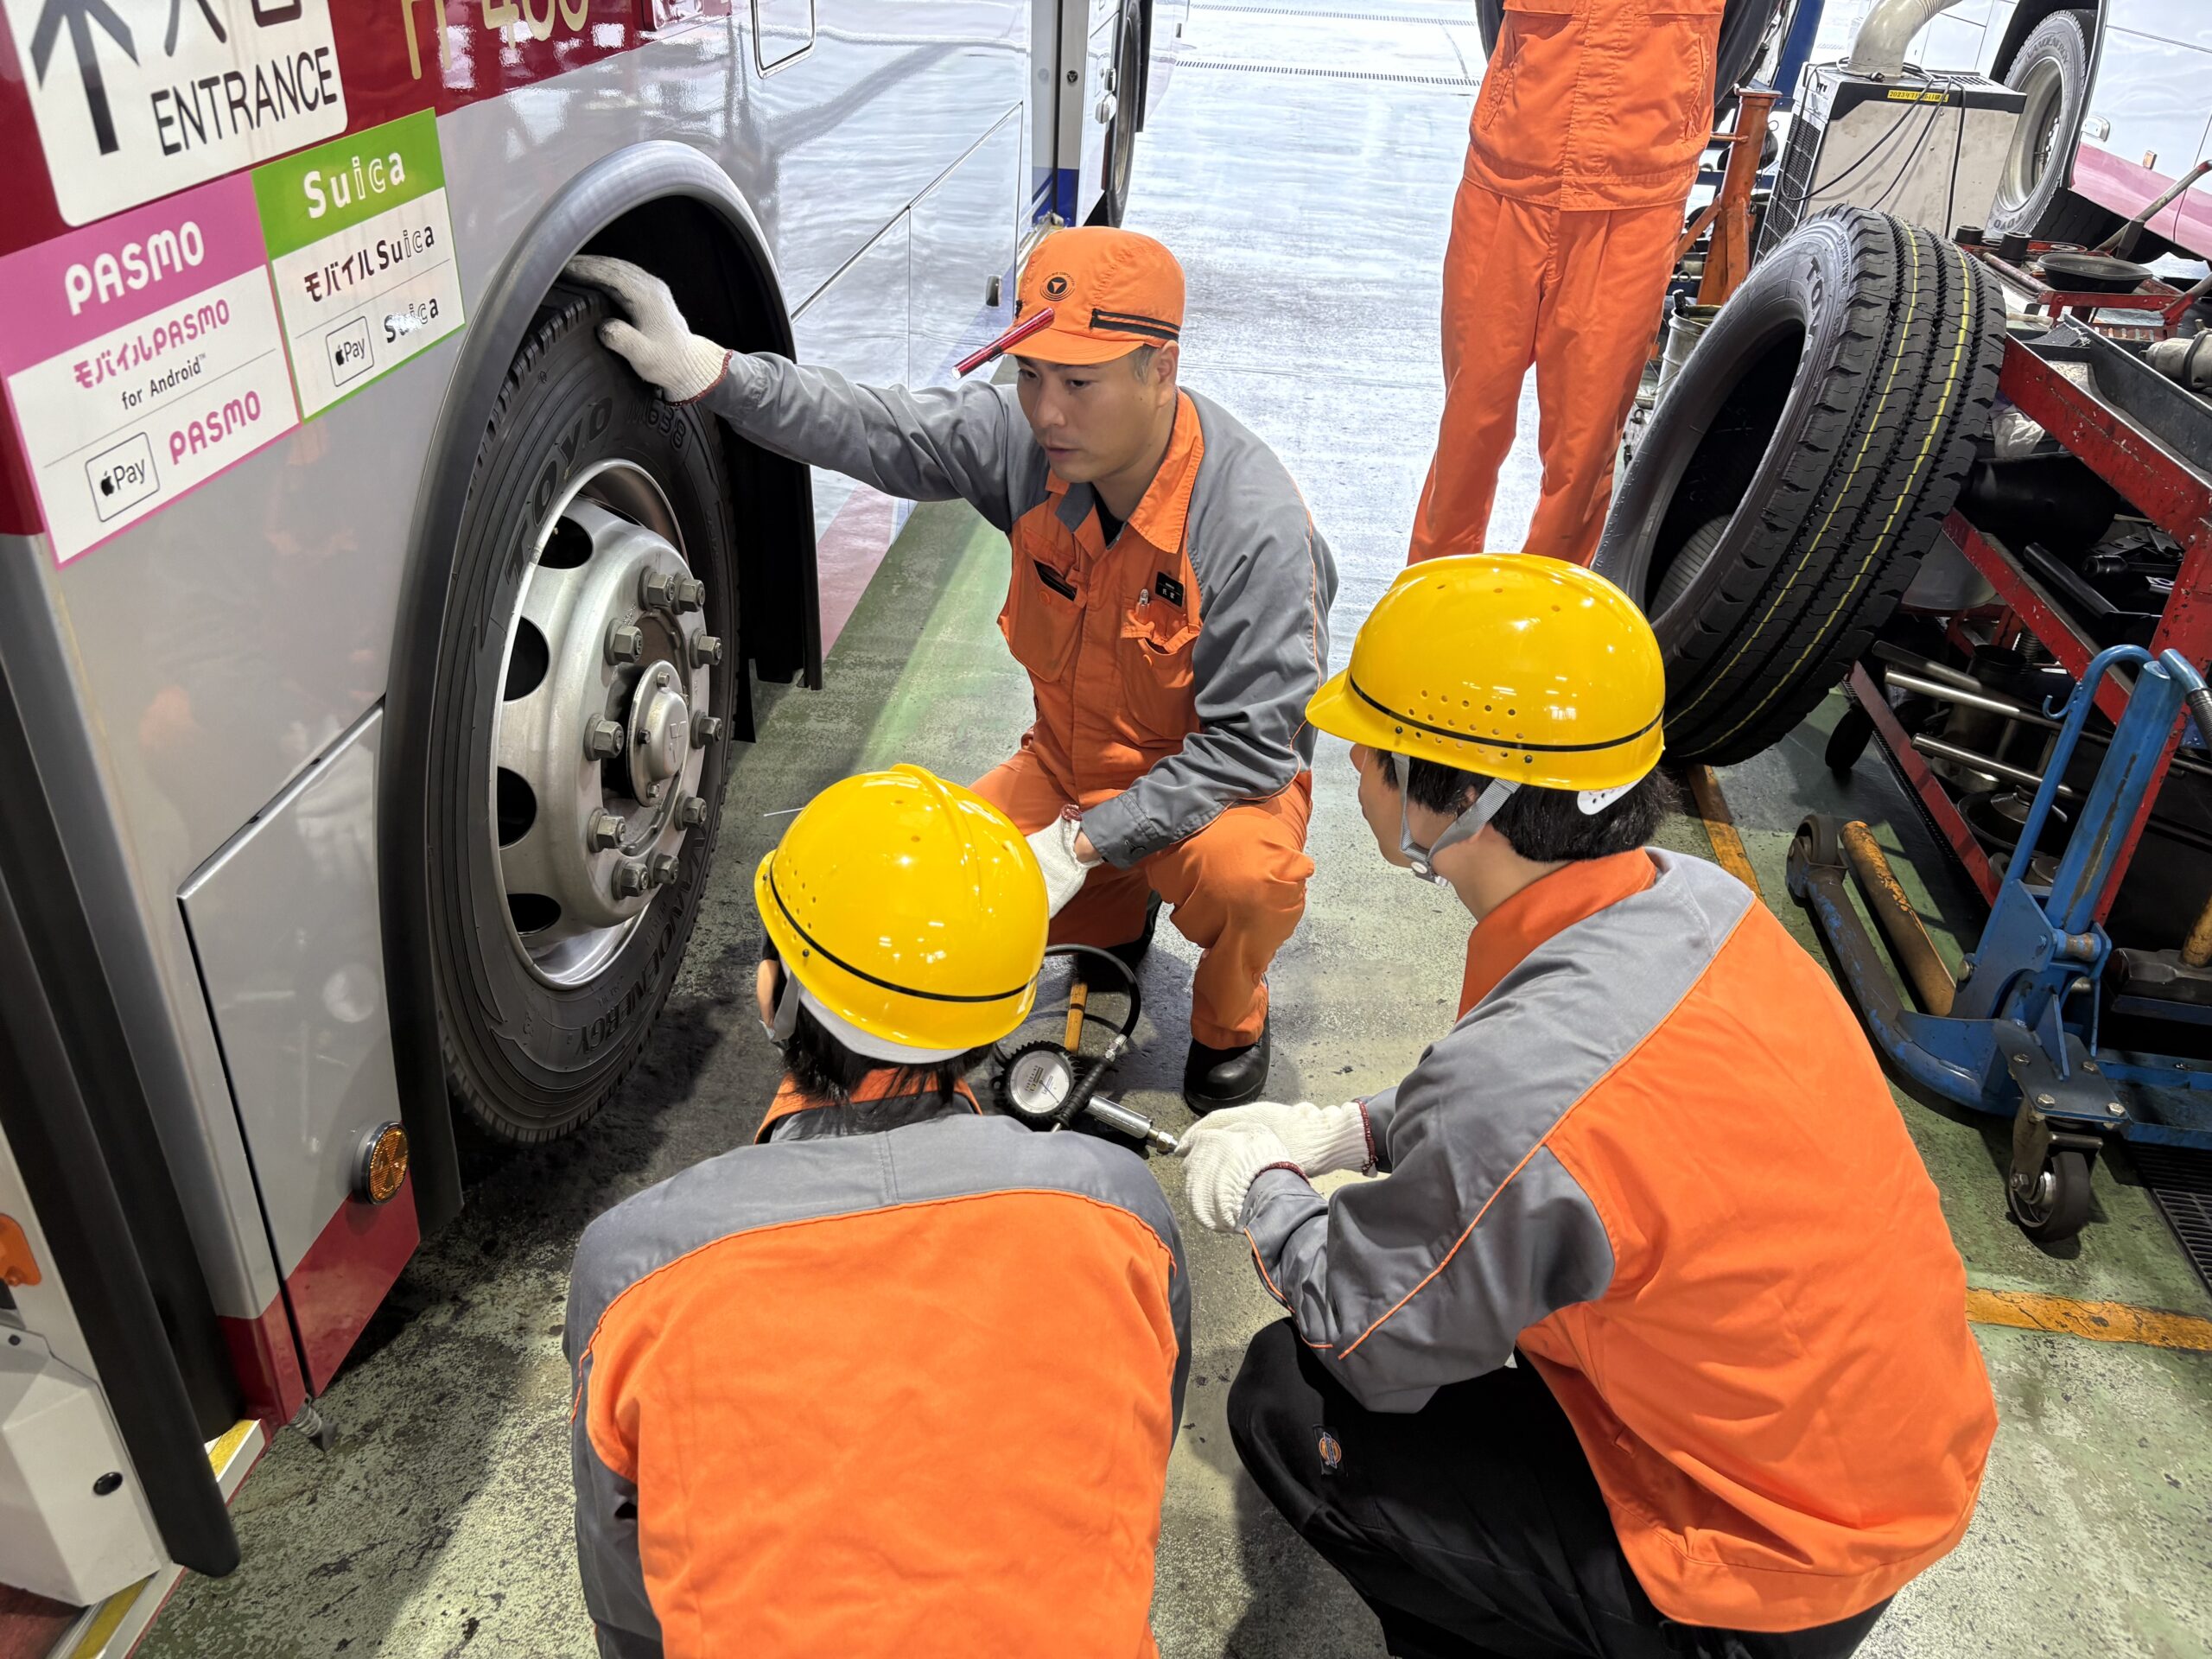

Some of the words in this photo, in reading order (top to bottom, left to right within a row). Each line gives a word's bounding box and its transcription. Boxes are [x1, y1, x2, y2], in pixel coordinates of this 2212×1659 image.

[150, 46, 337, 156] ENTRANCE
[303, 152, 406, 219] Suica
[65, 221, 205, 316] PASMO
[384, 298, 439, 343] Sica
[113, 459, 145, 490] Pay
[168, 391, 261, 466] PASMO
[121, 389, 143, 410] for
[505, 397, 613, 586] TOYO
